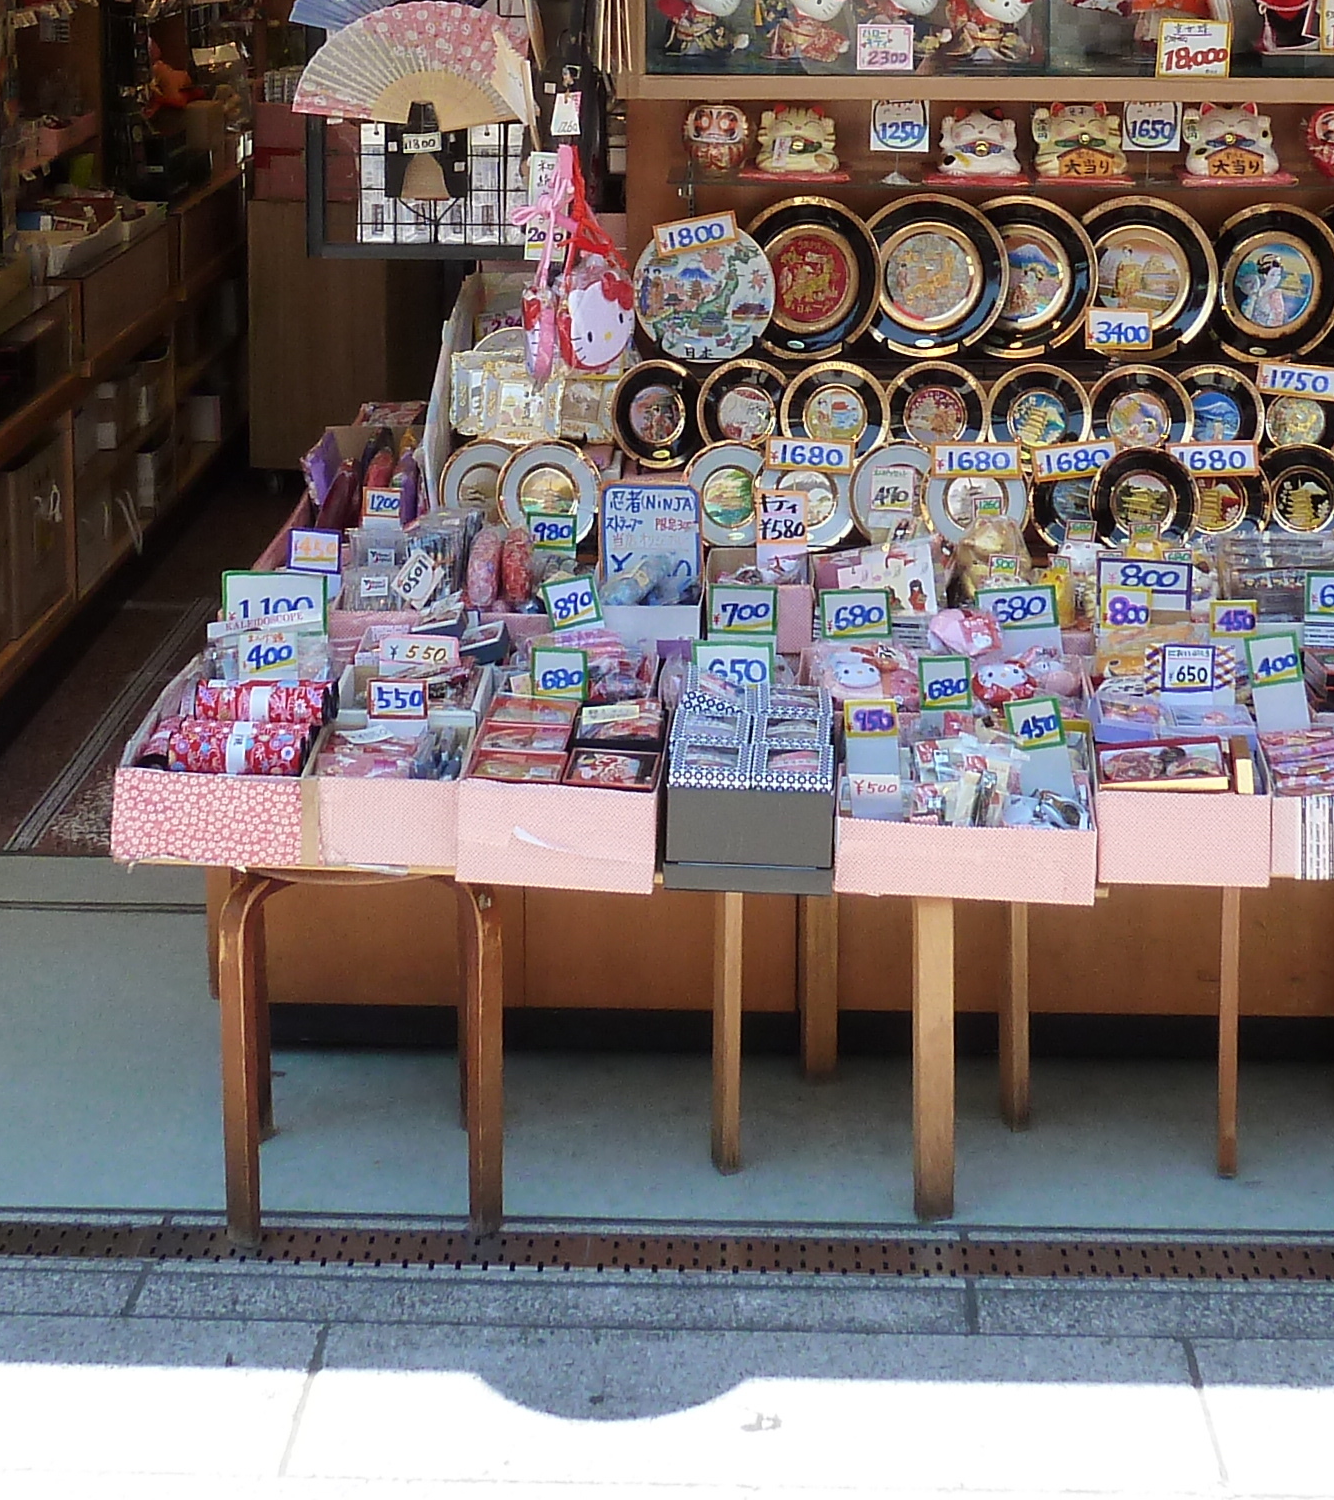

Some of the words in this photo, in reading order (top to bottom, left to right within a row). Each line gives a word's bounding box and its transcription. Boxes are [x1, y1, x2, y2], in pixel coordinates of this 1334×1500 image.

[1130, 119, 1174, 139] 1650
[1064, 158, 1110, 174] 大当り
[1212, 158, 1260, 174] 大当り
[770, 444, 844, 466] ¥1680
[937, 450, 1011, 472] ¥1680
[760, 518, 806, 540] ¥580
[225, 612, 304, 632] KALEIDOSCOPE
[854, 779, 898, 796] ¥500
